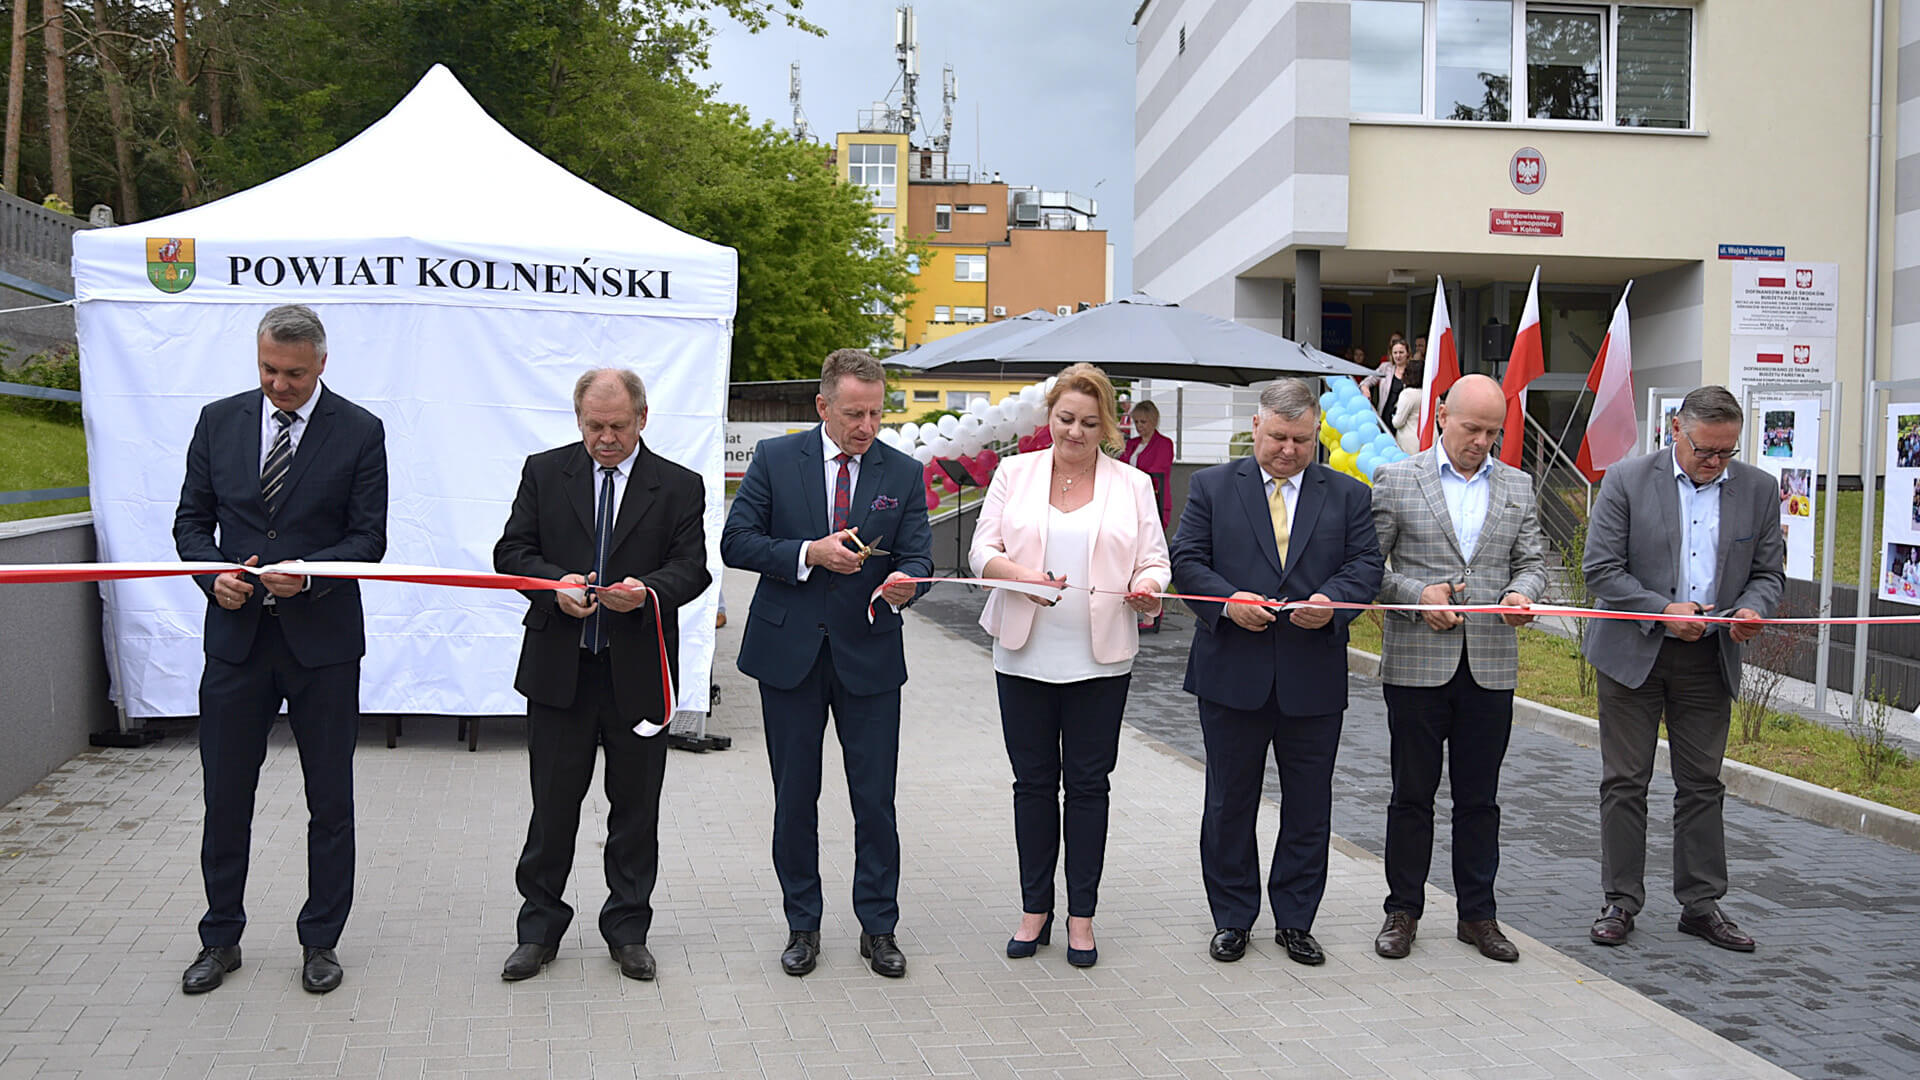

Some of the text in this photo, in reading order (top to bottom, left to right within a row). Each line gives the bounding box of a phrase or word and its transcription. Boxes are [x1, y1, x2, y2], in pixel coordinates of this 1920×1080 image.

[1513, 219, 1557, 229] Samopomocy
[1728, 247, 1748, 256] Wojska
[1749, 247, 1775, 257] Polskiego
[228, 256, 672, 299] POWIAT KOLNEŃSKI
